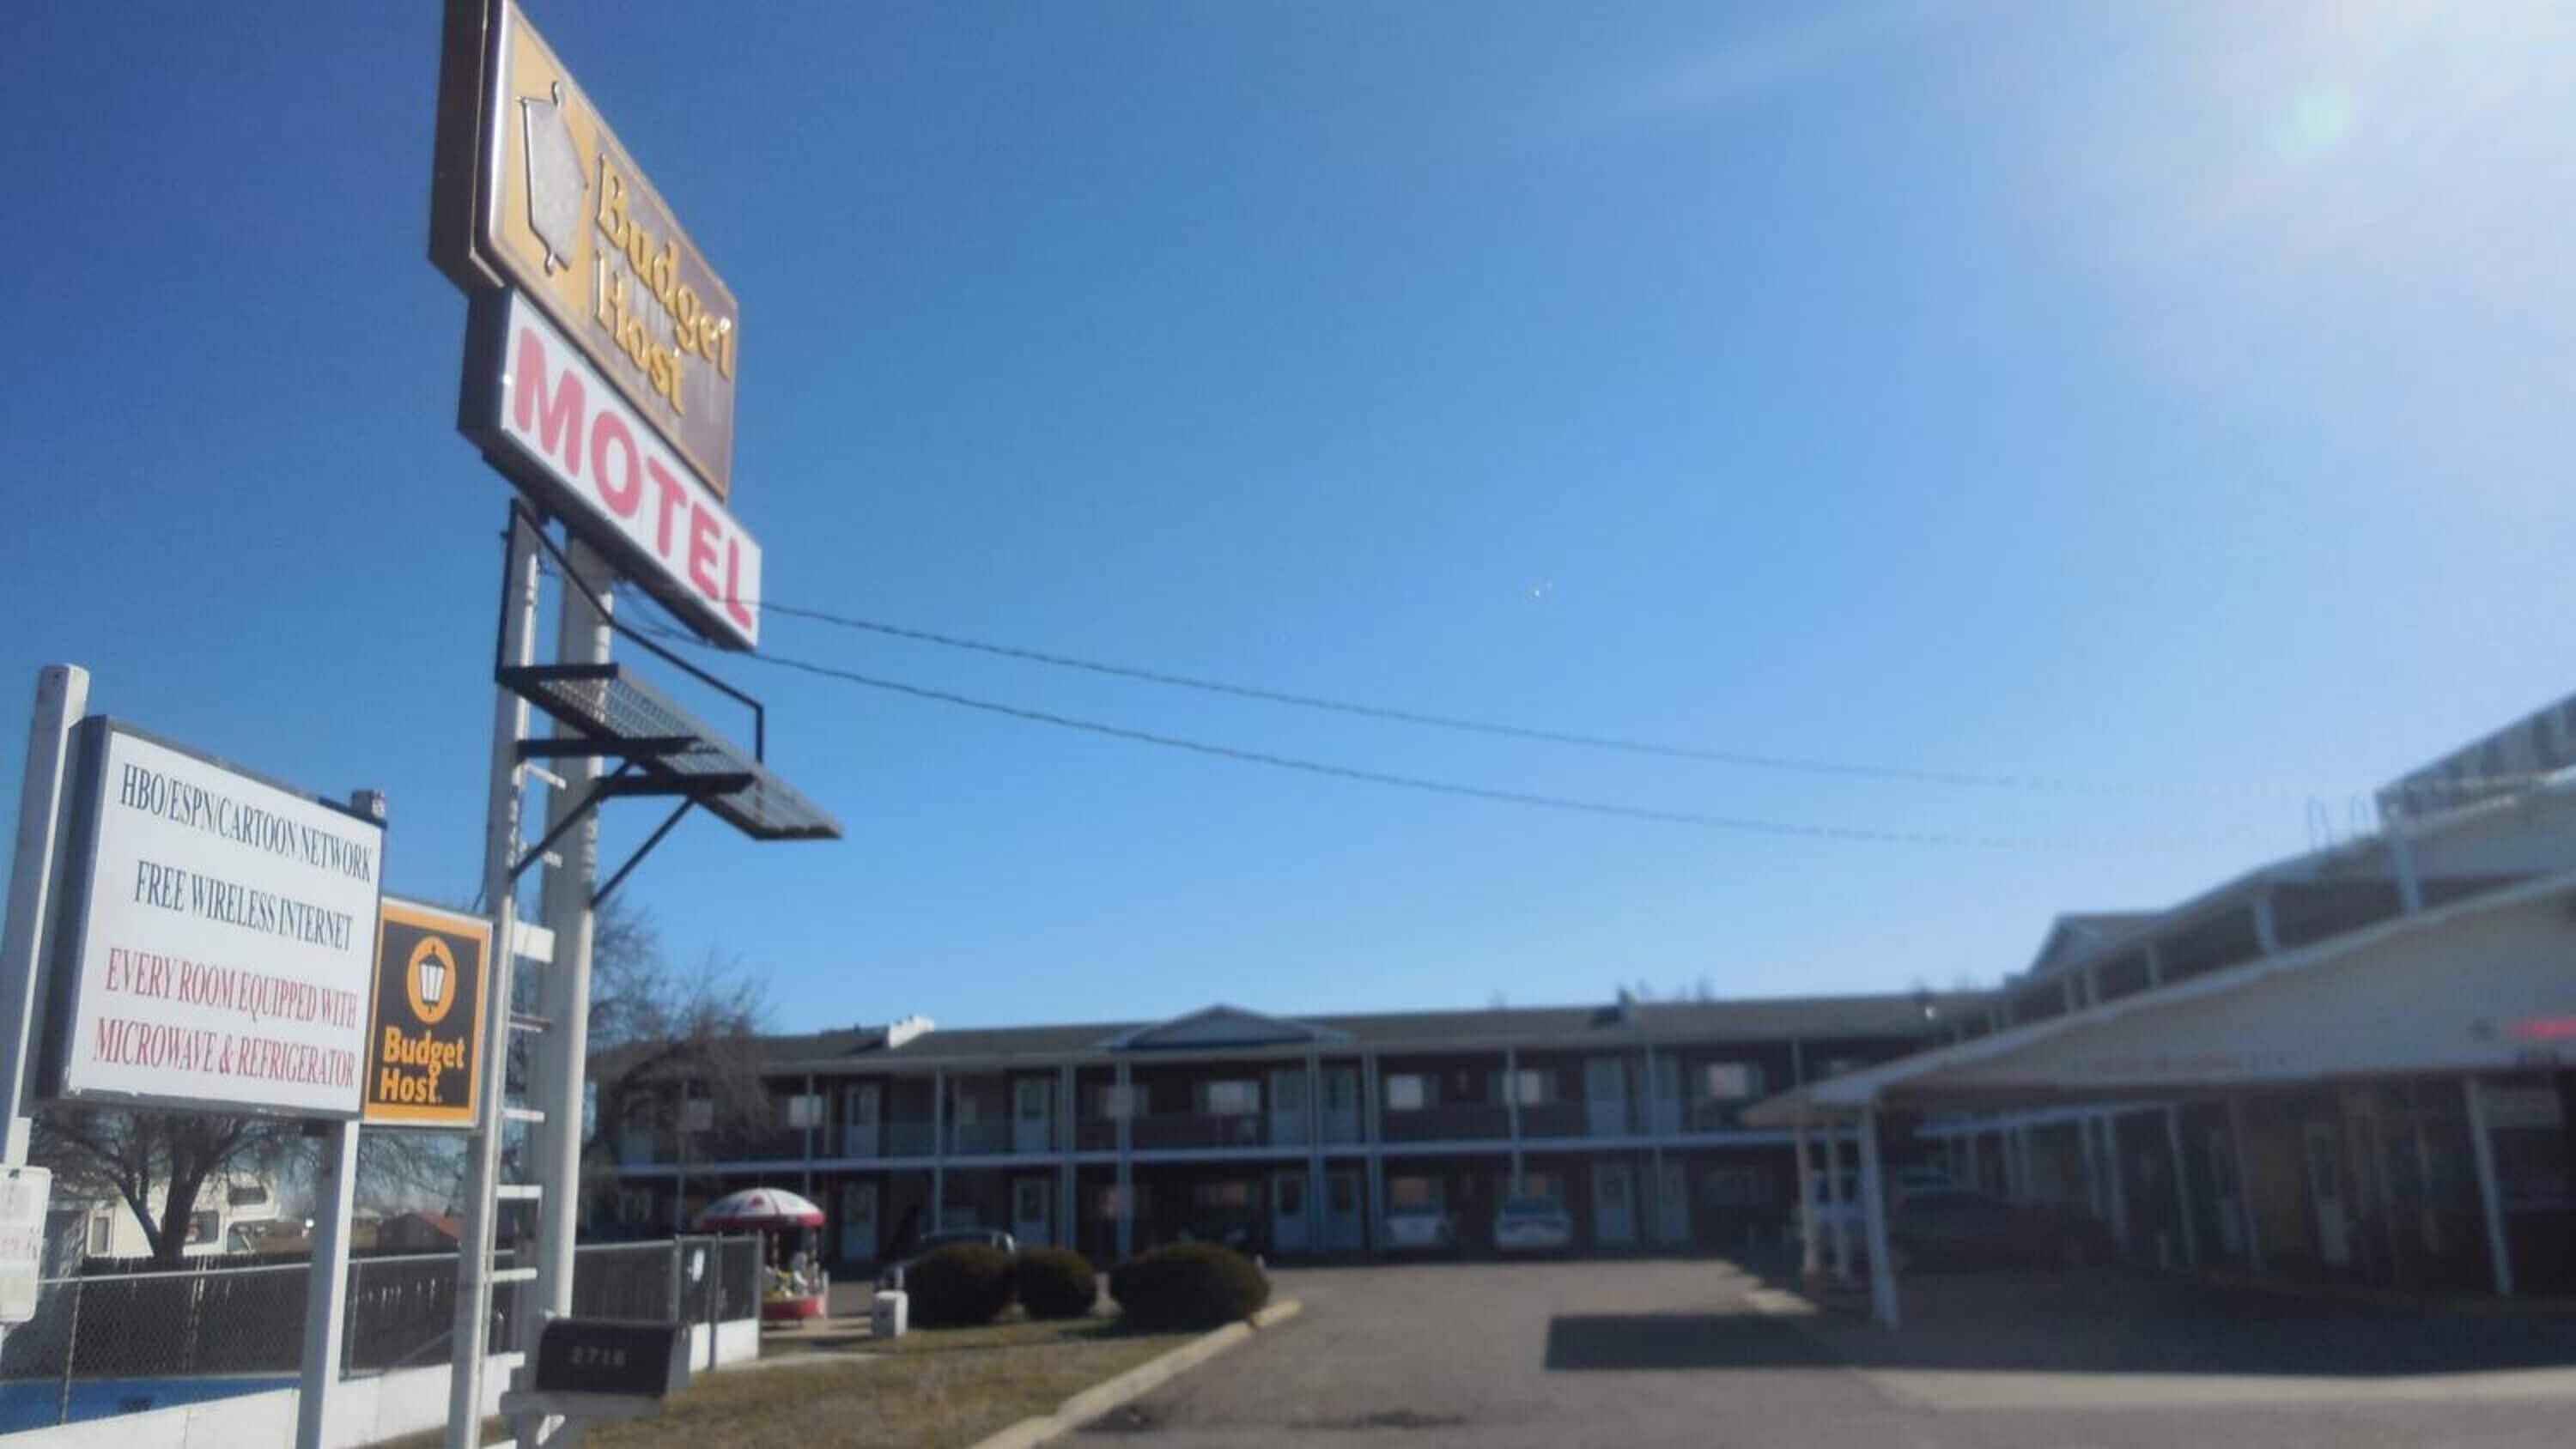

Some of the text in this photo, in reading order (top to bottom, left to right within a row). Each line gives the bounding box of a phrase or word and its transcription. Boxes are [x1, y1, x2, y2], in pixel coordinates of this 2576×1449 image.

[596, 152, 731, 381] Budget
[594, 249, 685, 416] Host
[515, 327, 753, 631] MOTEL
[120, 762, 373, 884] HBO/ESPN/CARTOON NETWORK
[134, 859, 354, 951] FREE WIRELESS INTERNET
[105, 947, 359, 1030] EVERY ROOM EQUIPPED WITH
[92, 1016, 356, 1091] MICROWAVE & REFRIGERATOR
[380, 1066, 440, 1104] Host
[383, 1025, 466, 1079] Budget
